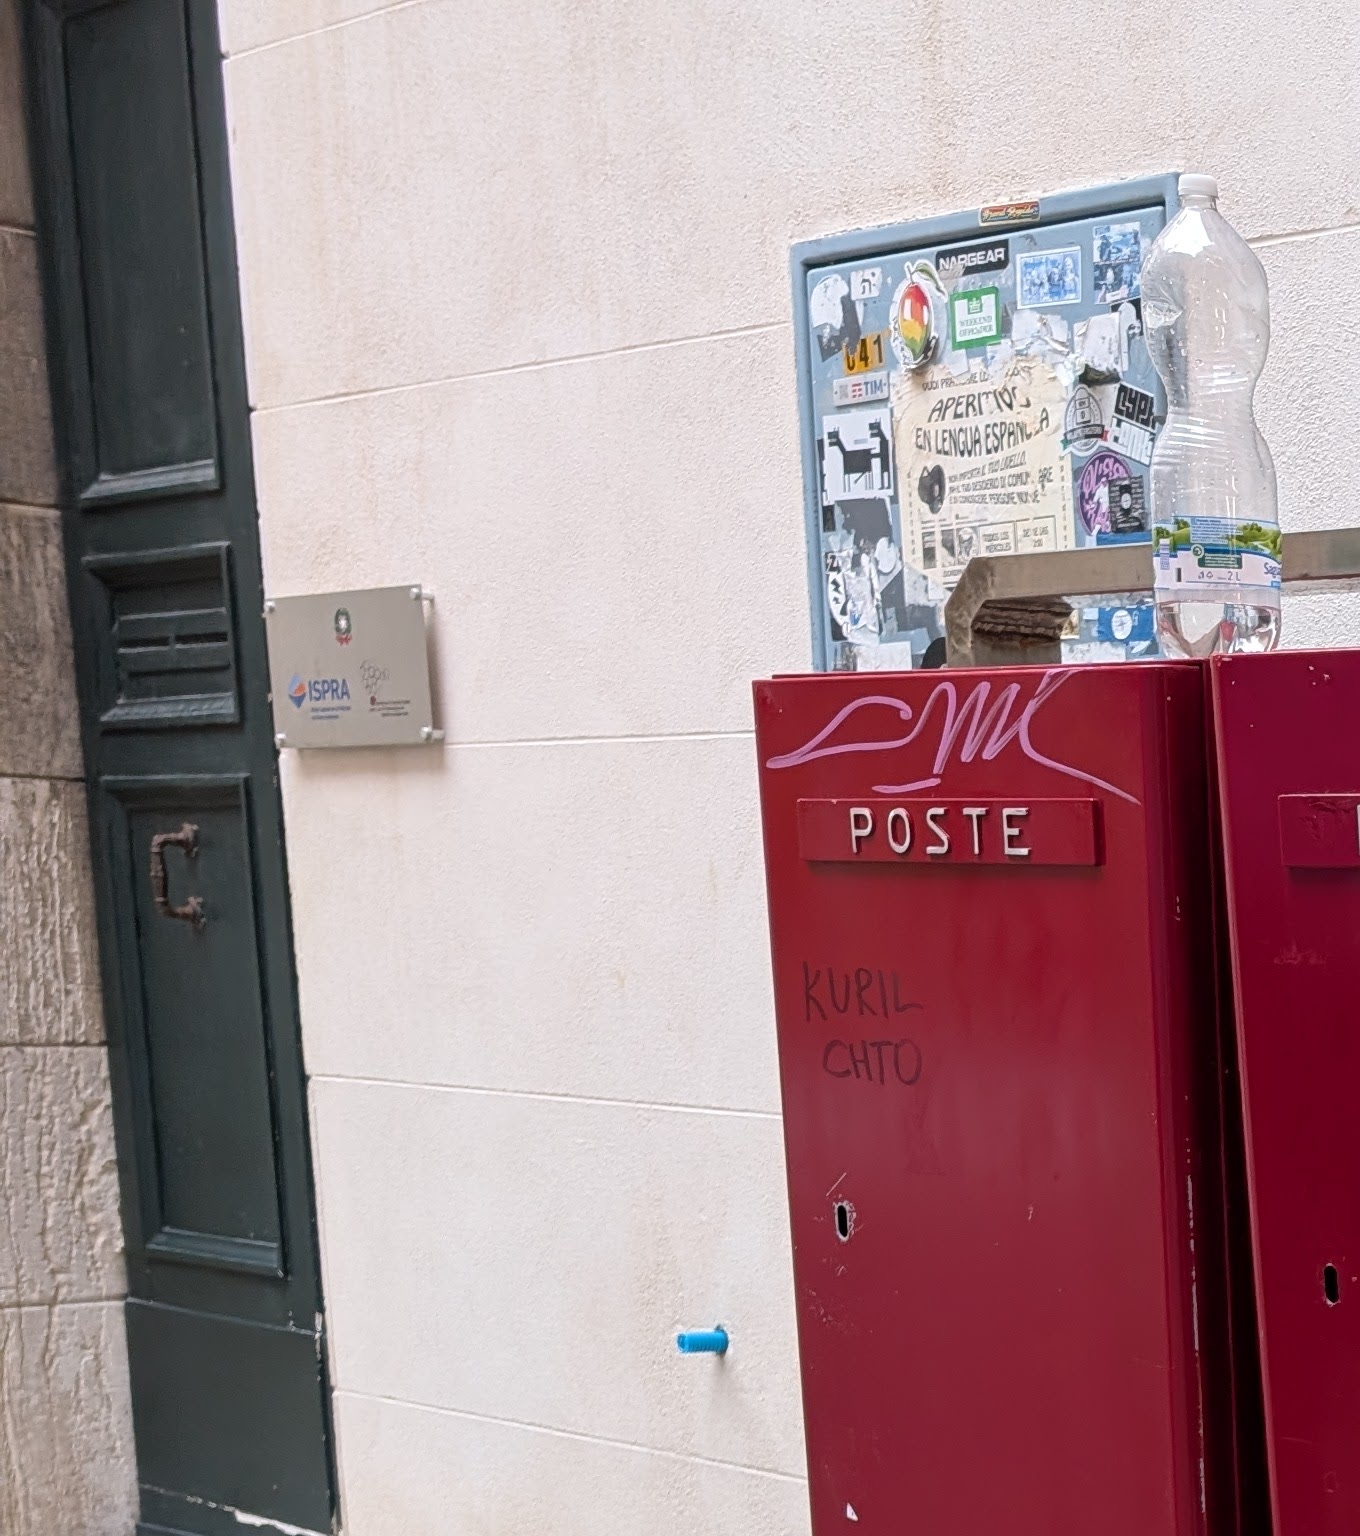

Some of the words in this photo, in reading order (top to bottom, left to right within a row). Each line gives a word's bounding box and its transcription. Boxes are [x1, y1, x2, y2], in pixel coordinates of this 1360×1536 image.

[863, 378, 884, 396] TIM
[915, 427, 933, 453] EN
[935, 425, 982, 458] LENGUA
[308, 678, 350, 702] ISPRA
[849, 807, 1032, 857] POSTE
[803, 961, 924, 1022] KURIL
